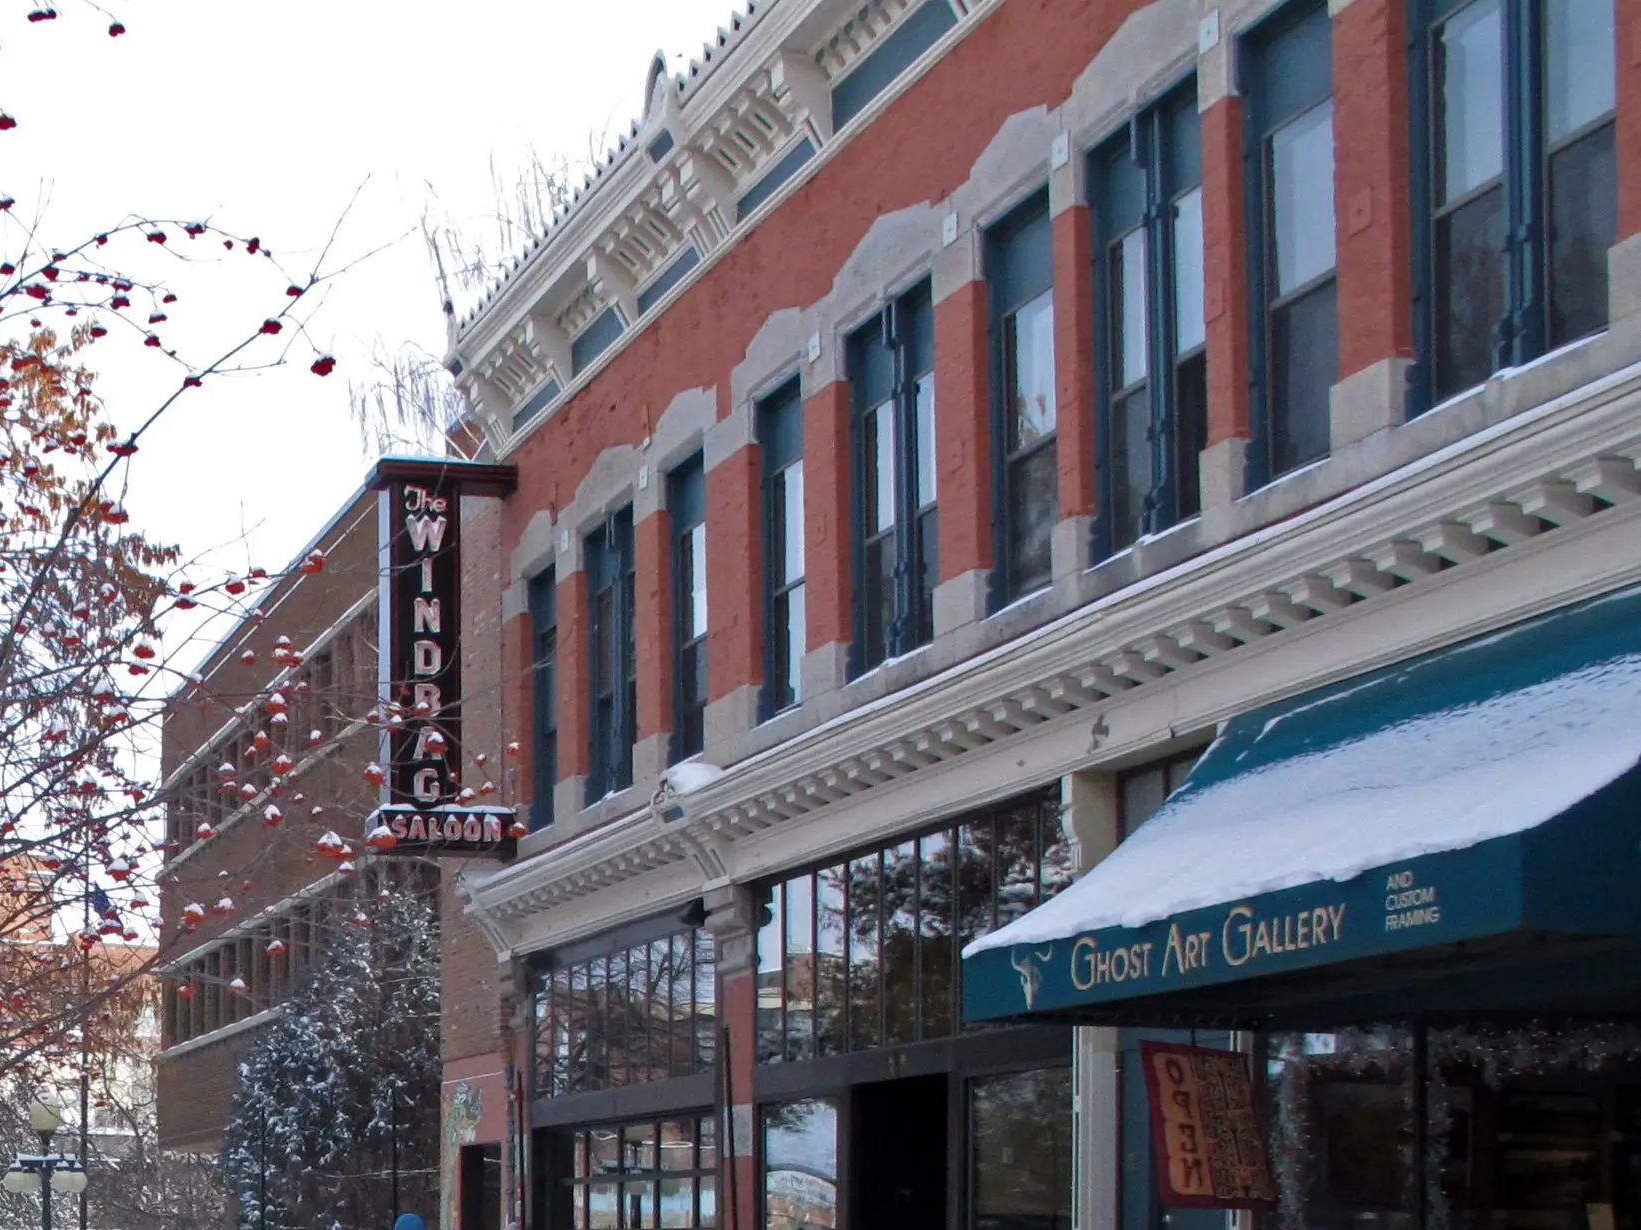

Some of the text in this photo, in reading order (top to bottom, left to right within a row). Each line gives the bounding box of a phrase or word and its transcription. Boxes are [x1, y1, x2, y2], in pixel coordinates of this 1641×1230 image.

[404, 486, 447, 512] The
[391, 814, 501, 842] SALOON
[1386, 871, 1413, 891] AND
[1385, 886, 1435, 911] CUSTOM
[1385, 906, 1440, 931] FRAMING
